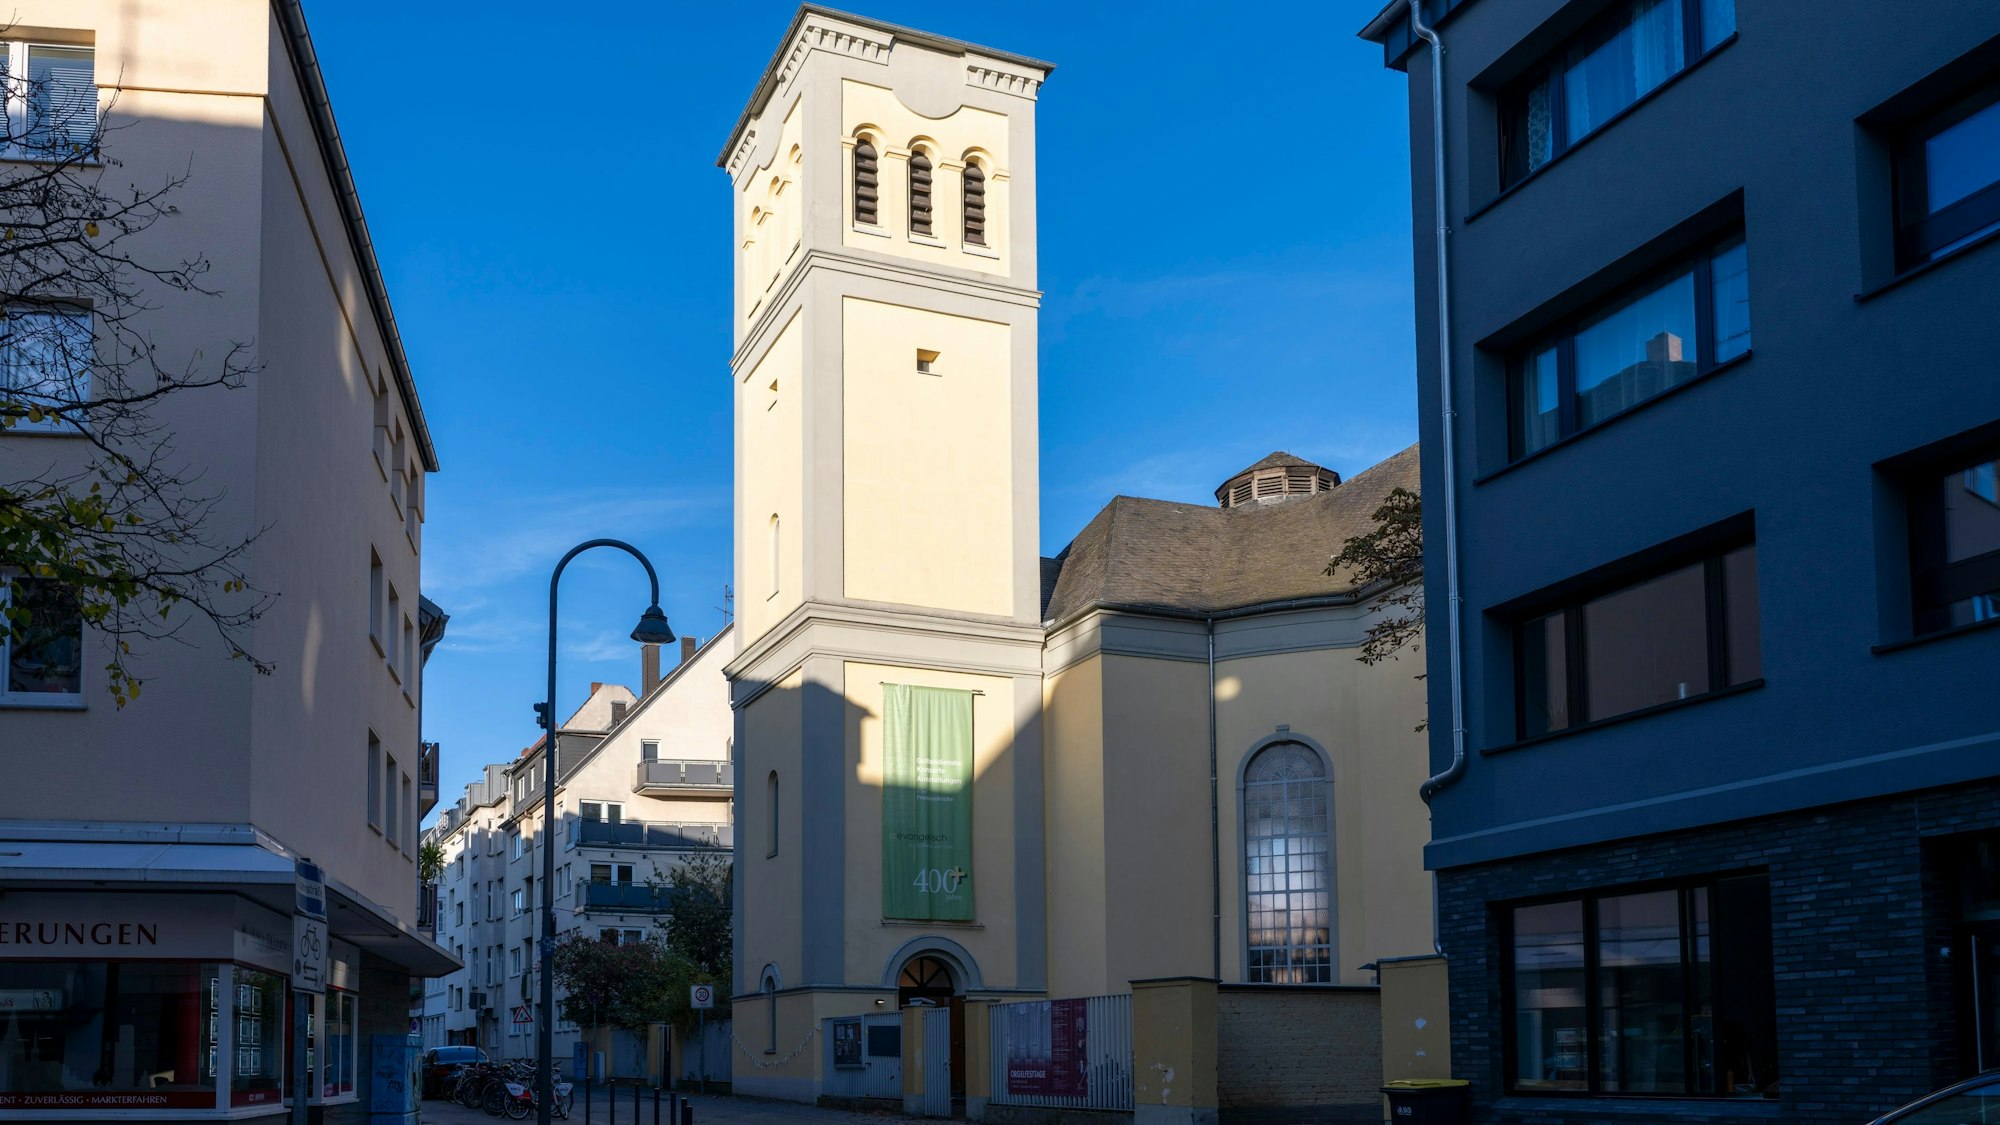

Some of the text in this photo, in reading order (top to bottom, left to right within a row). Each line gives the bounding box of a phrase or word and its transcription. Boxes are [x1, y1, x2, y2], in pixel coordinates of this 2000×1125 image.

[916, 766, 945, 774] Konzerte
[916, 776, 962, 785] Ausstellungen
[697, 990, 707, 999] 30
[24, 1094, 84, 1105] ZUVERLÄSSIG
[91, 1096, 168, 1104] MARKTERFAHREN
